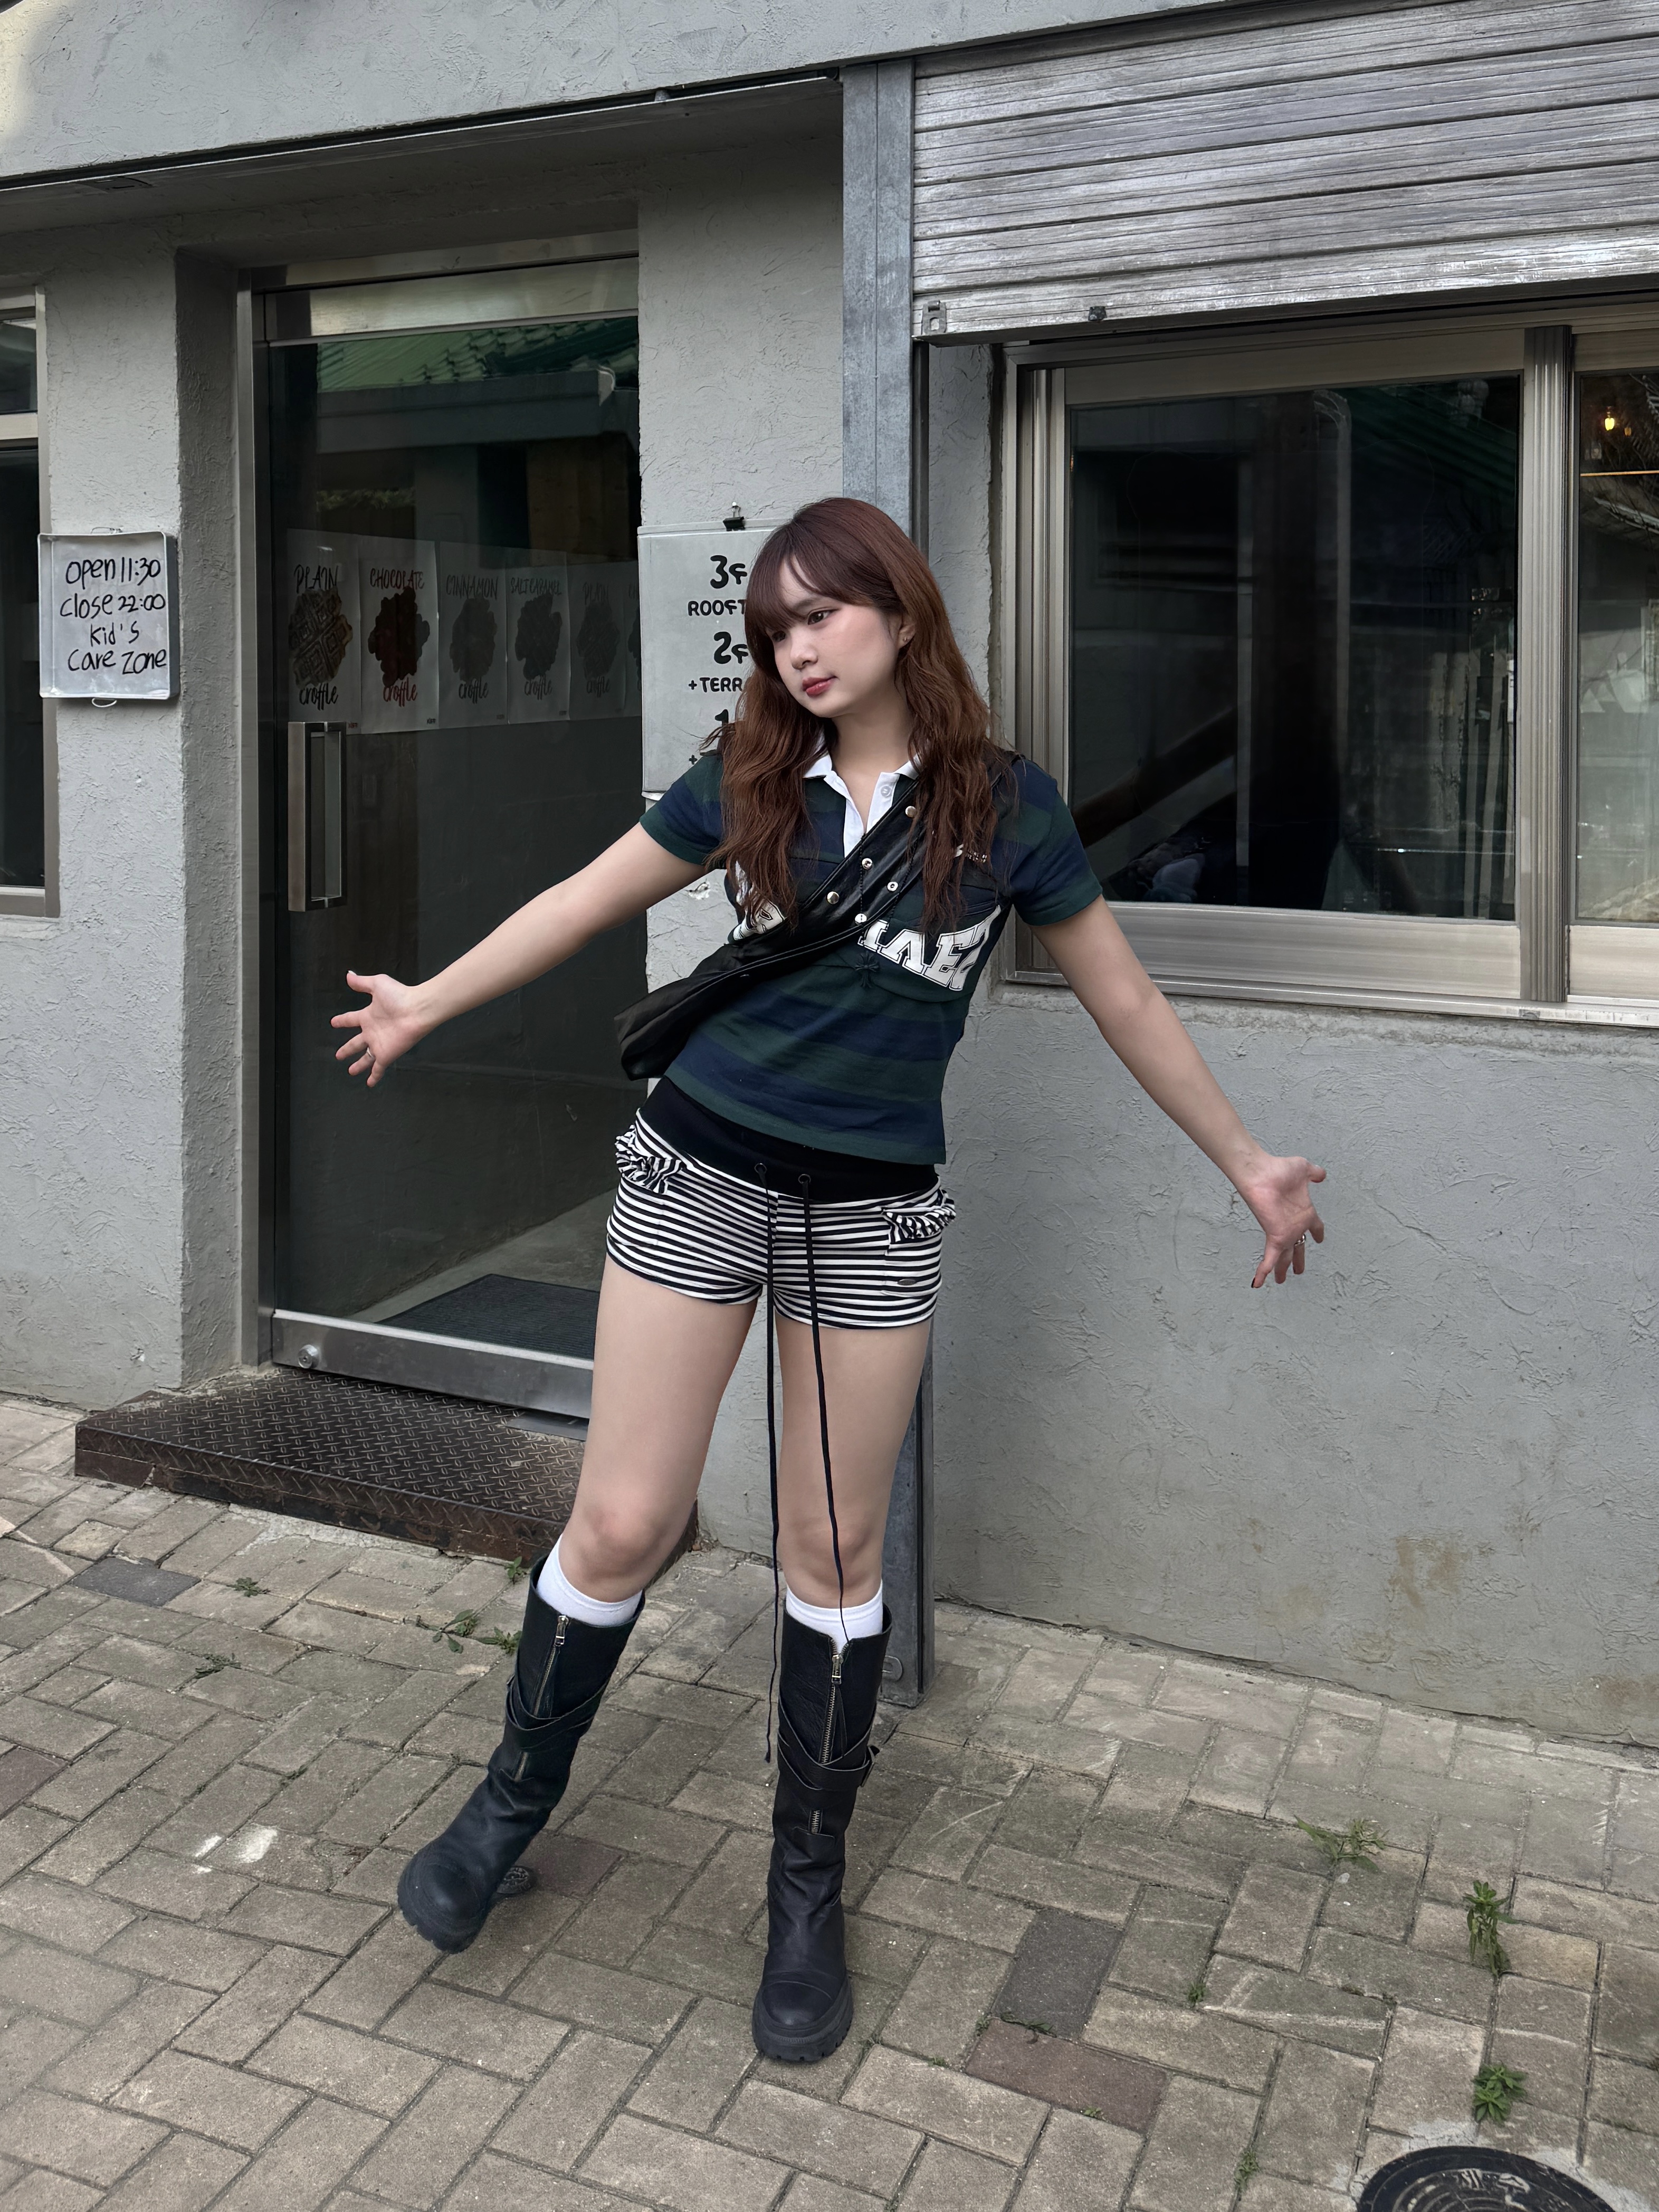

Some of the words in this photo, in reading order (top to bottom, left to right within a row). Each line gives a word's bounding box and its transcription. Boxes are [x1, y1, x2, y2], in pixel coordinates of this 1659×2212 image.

[121, 557, 161, 586] 11:30
[294, 565, 339, 594] PLAIN
[369, 567, 425, 589] CHOCOLATE
[710, 555, 748, 589] 3F
[446, 575, 498, 599] CINNAMON
[118, 594, 166, 613] 22:00
[713, 631, 749, 664] 2F
[299, 683, 339, 710] croffle
[383, 678, 417, 707] croffle
[459, 678, 489, 704] croffle
[525, 675, 553, 700] croffle
